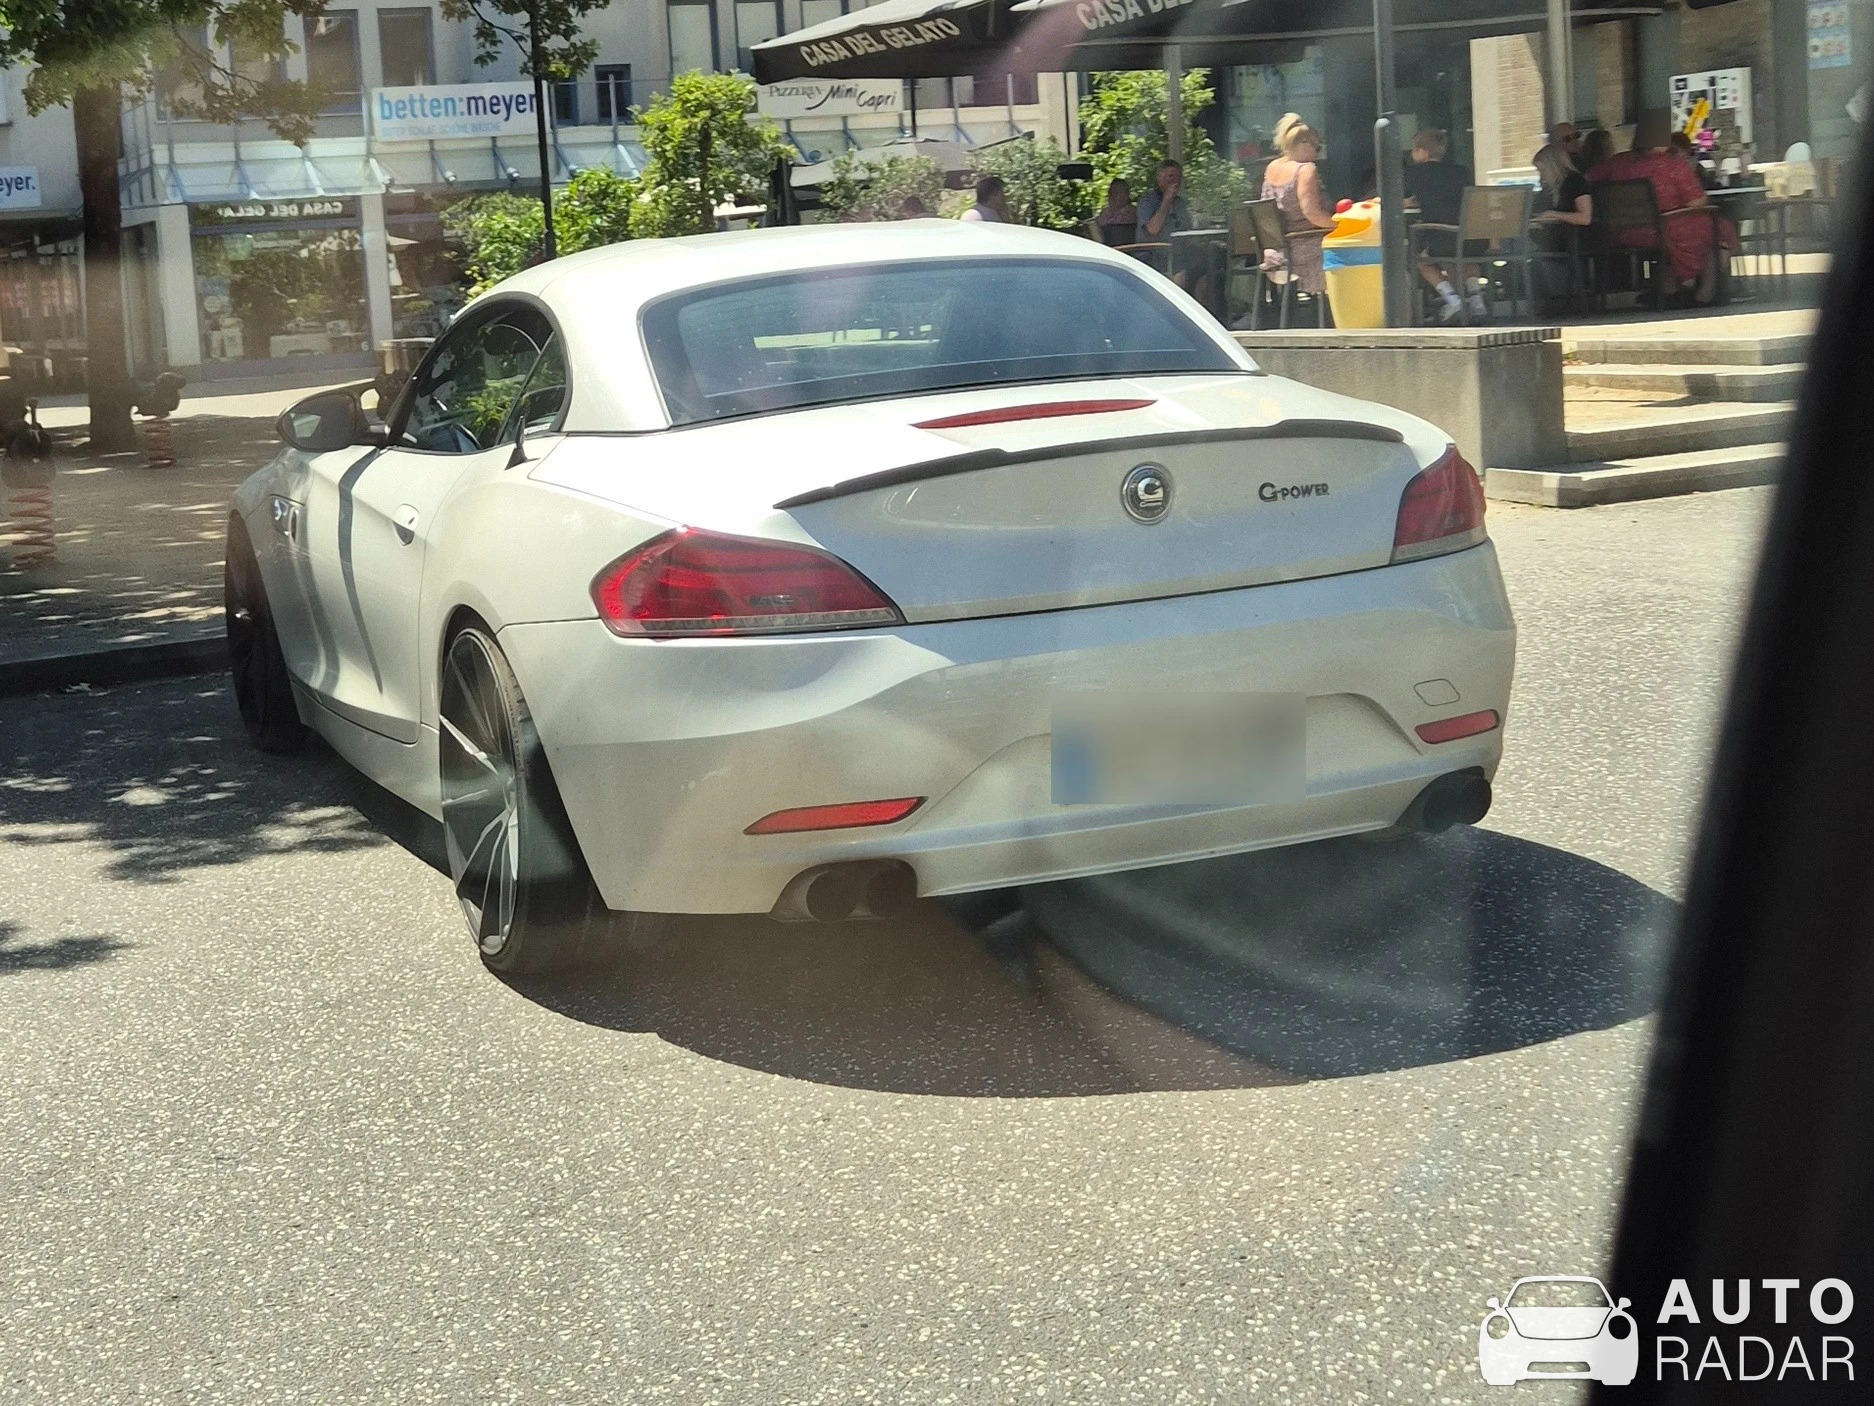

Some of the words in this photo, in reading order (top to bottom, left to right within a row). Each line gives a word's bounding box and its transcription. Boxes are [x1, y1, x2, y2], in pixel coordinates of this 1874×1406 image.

[1076, 0, 1145, 30] CASA
[800, 36, 852, 67] CASA
[846, 32, 887, 56] DEL
[879, 17, 961, 49] GELATO
[856, 90, 898, 111] Capri
